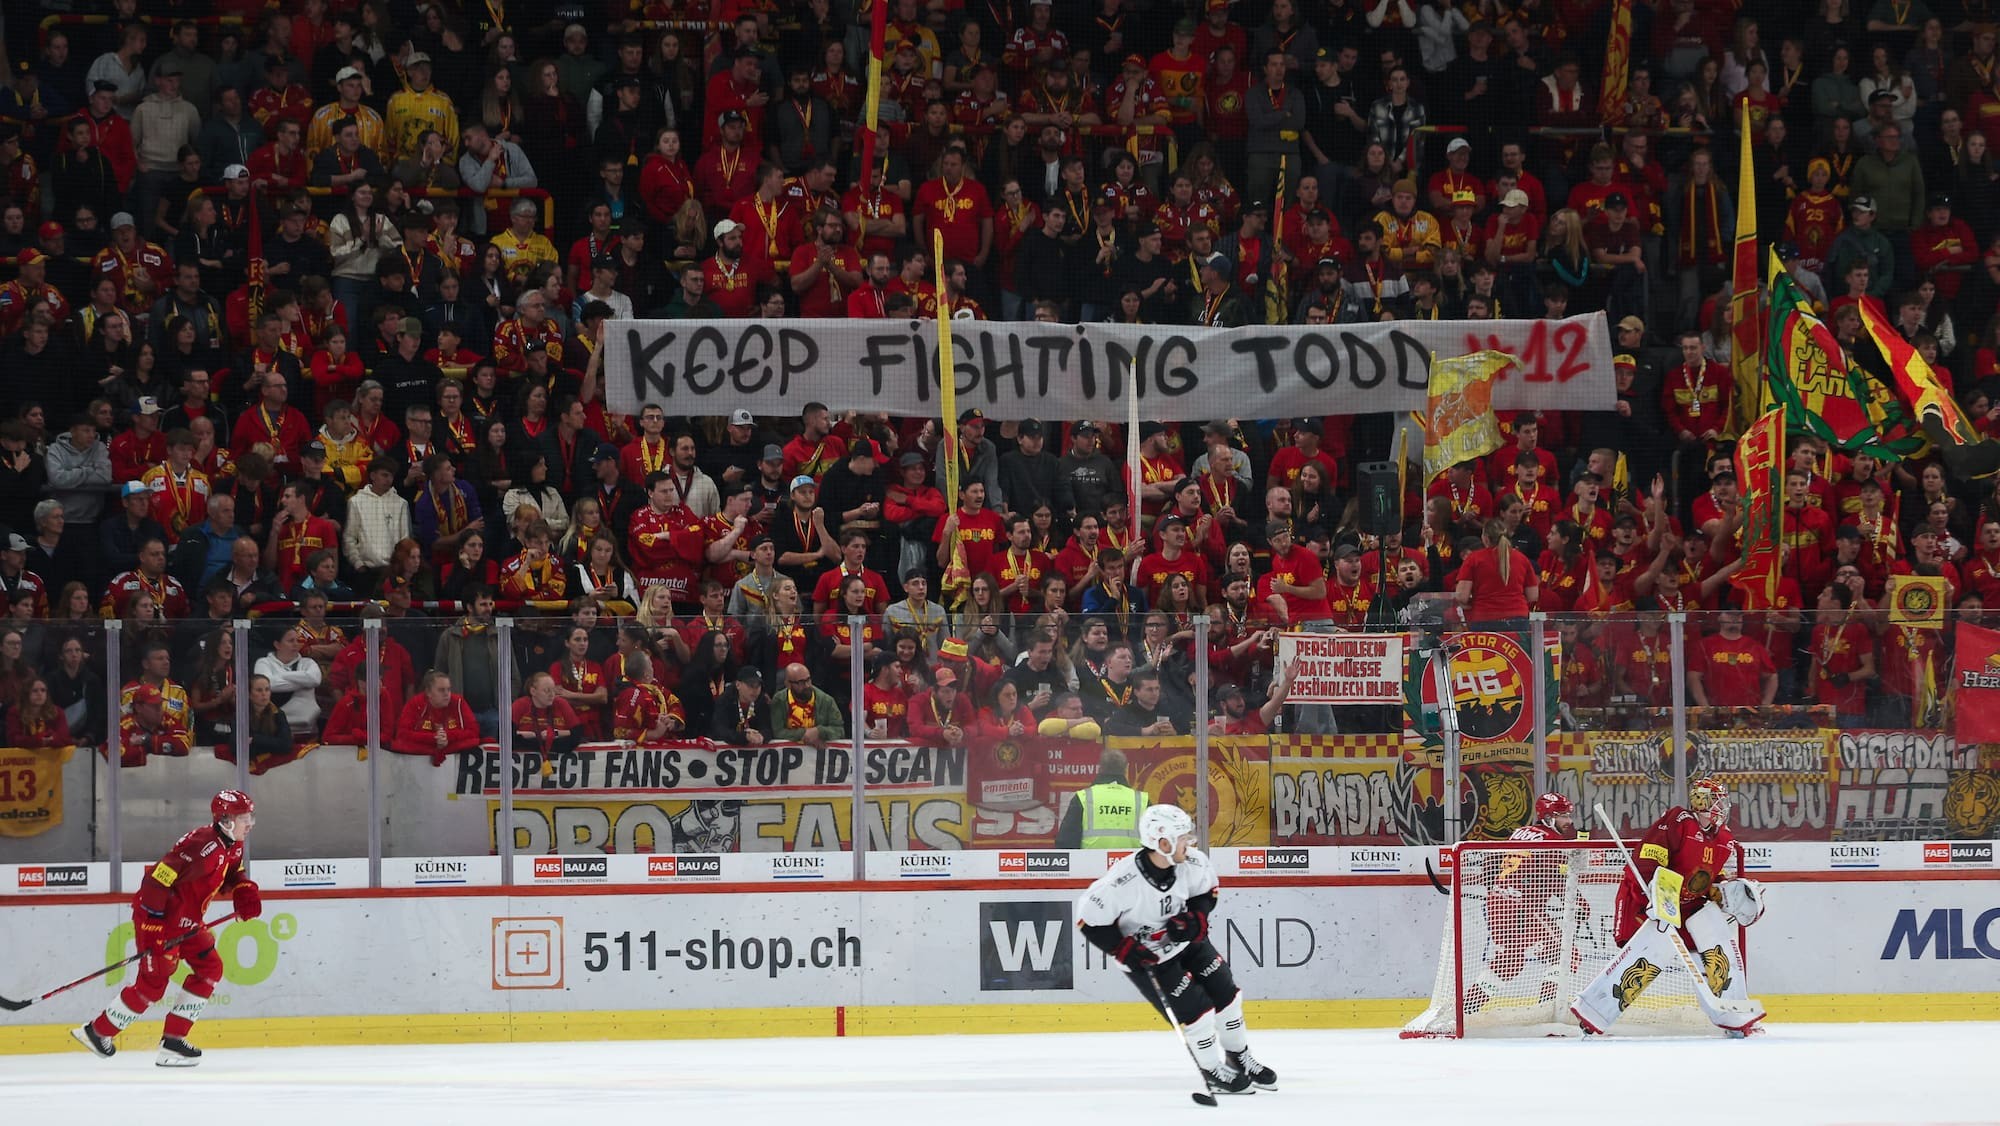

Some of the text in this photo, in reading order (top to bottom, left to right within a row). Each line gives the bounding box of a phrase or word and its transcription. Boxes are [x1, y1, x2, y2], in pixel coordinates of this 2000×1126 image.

[627, 324, 820, 402] KEEP
[1232, 330, 1430, 394] TODD
[1502, 641, 1520, 660] 46
[1290, 677, 1363, 697] ERSÖNDLECH
[1456, 669, 1502, 696] 46
[456, 747, 596, 795] RESPECT
[604, 750, 681, 788] FANS
[714, 747, 803, 786] STOP
[1099, 805, 1132, 815] STAFF
[1273, 769, 1397, 837] BANDA
[1001, 857, 1068, 868] FAES BAU AG
[1240, 855, 1308, 864] FAES BAU AG
[1703, 846, 1714, 864] 91
[1925, 849, 1992, 858] FAES BAU AG
[536, 863, 605, 872] FAES BAU AG
[650, 861, 718, 871] FAES BAU AG
[19, 869, 86, 883] FAES BAU AG
[1159, 895, 1172, 917] 12
[584, 927, 862, 978] 511-shop.ch
